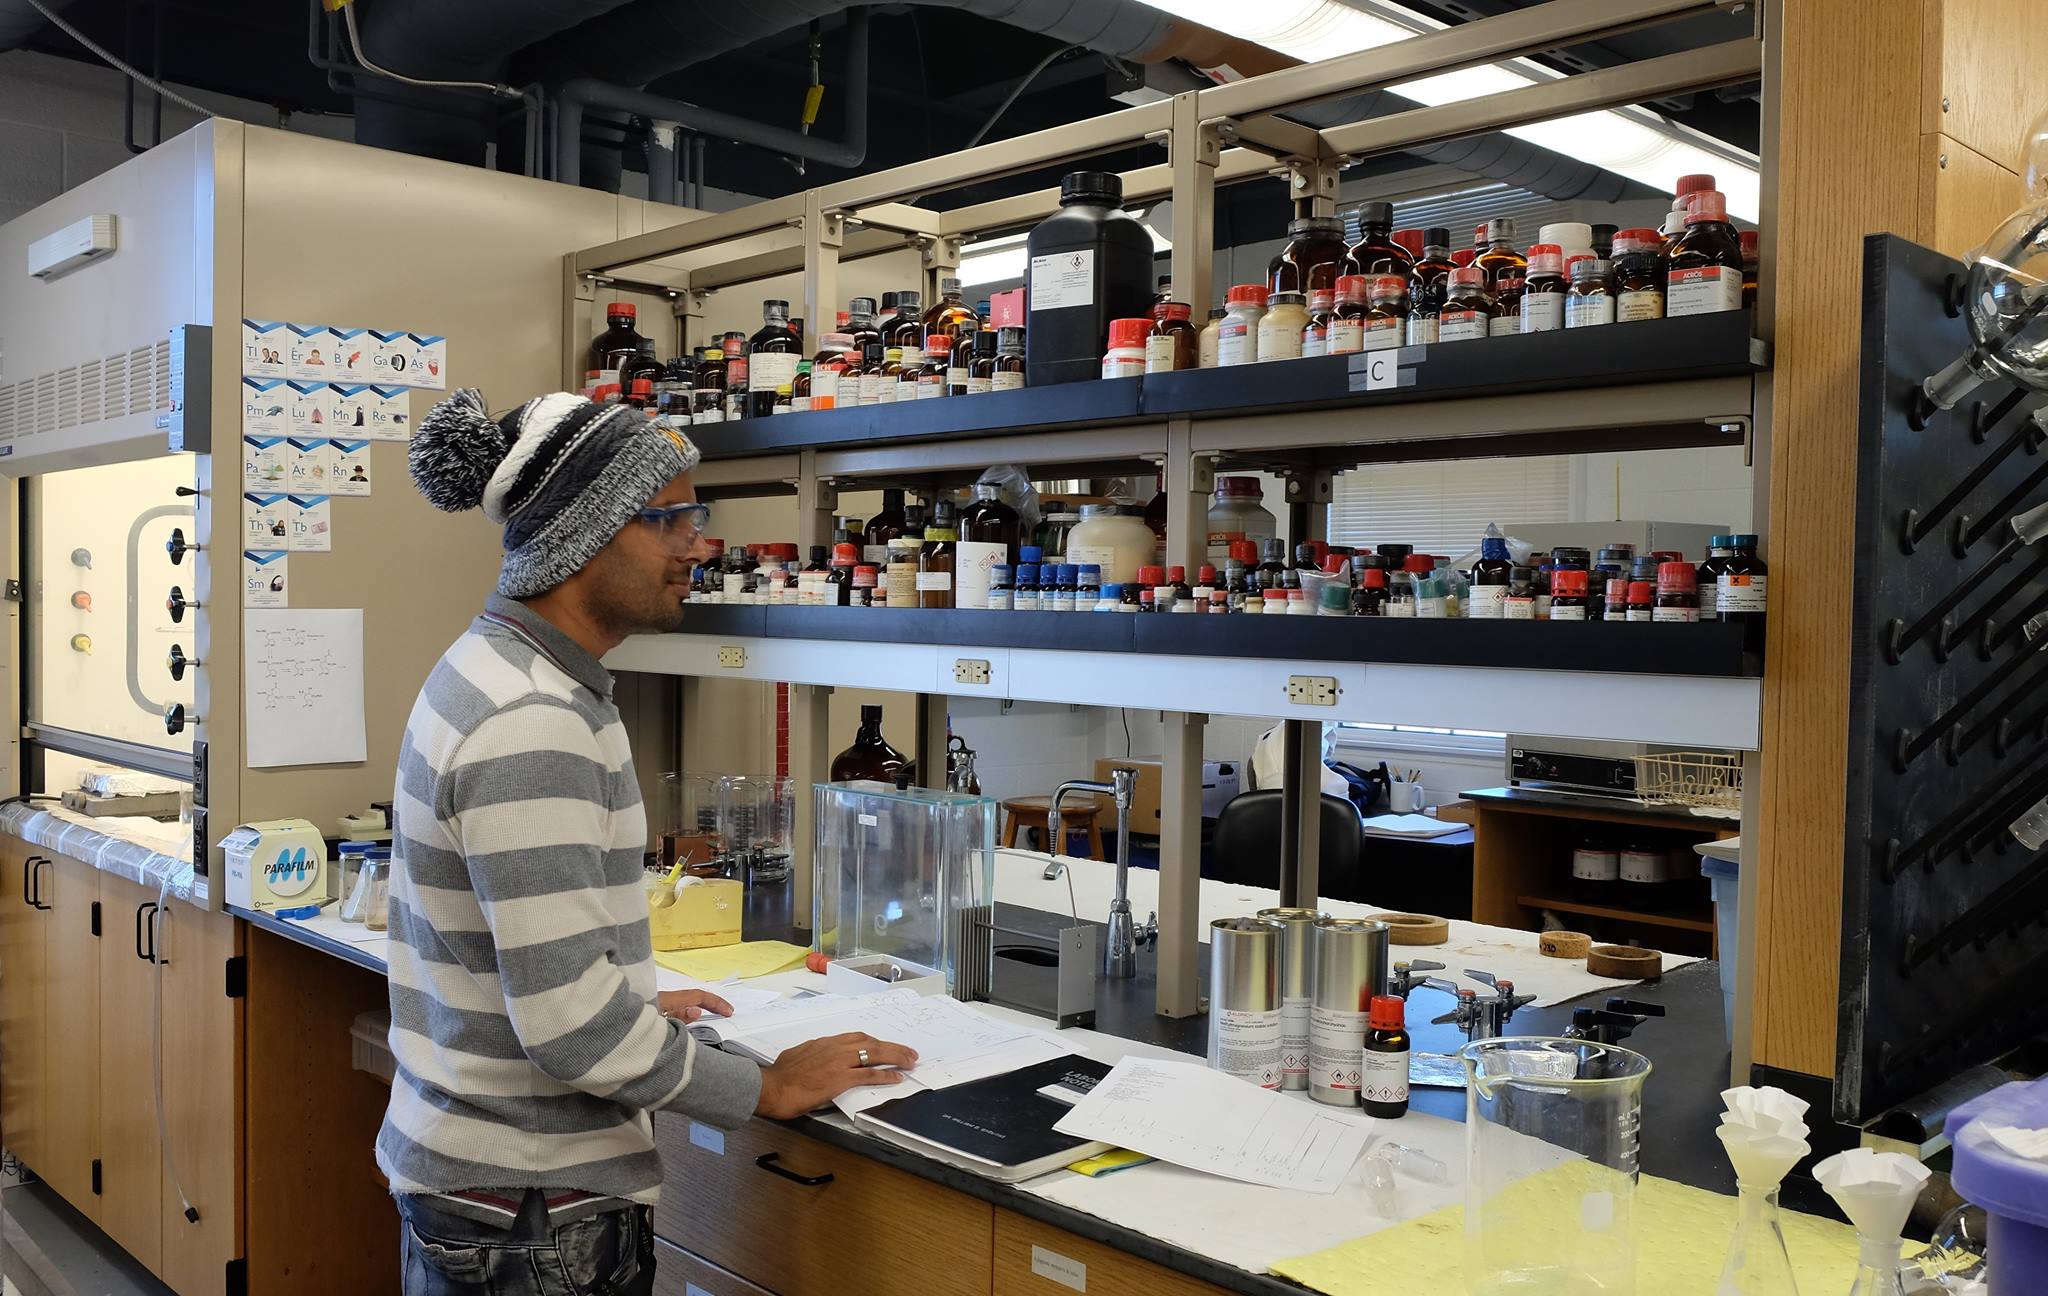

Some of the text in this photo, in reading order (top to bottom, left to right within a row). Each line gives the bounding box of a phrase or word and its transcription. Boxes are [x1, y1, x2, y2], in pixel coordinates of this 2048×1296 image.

[291, 350, 302, 361] Er
[334, 353, 342, 363] B
[373, 355, 388, 366] Ga
[410, 358, 424, 369] As
[1371, 360, 1385, 382] C
[246, 405, 264, 416] Pm
[292, 407, 305, 418] Lu
[333, 409, 349, 420] Mn
[372, 410, 386, 422] Re
[246, 462, 259, 473] Pa
[292, 465, 306, 476] At
[333, 465, 347, 476] Rn
[249, 519, 264, 531] Th
[292, 521, 307, 532] Tb
[248, 578, 264, 589] Sm
[264, 860, 315, 875] PARAFILM
